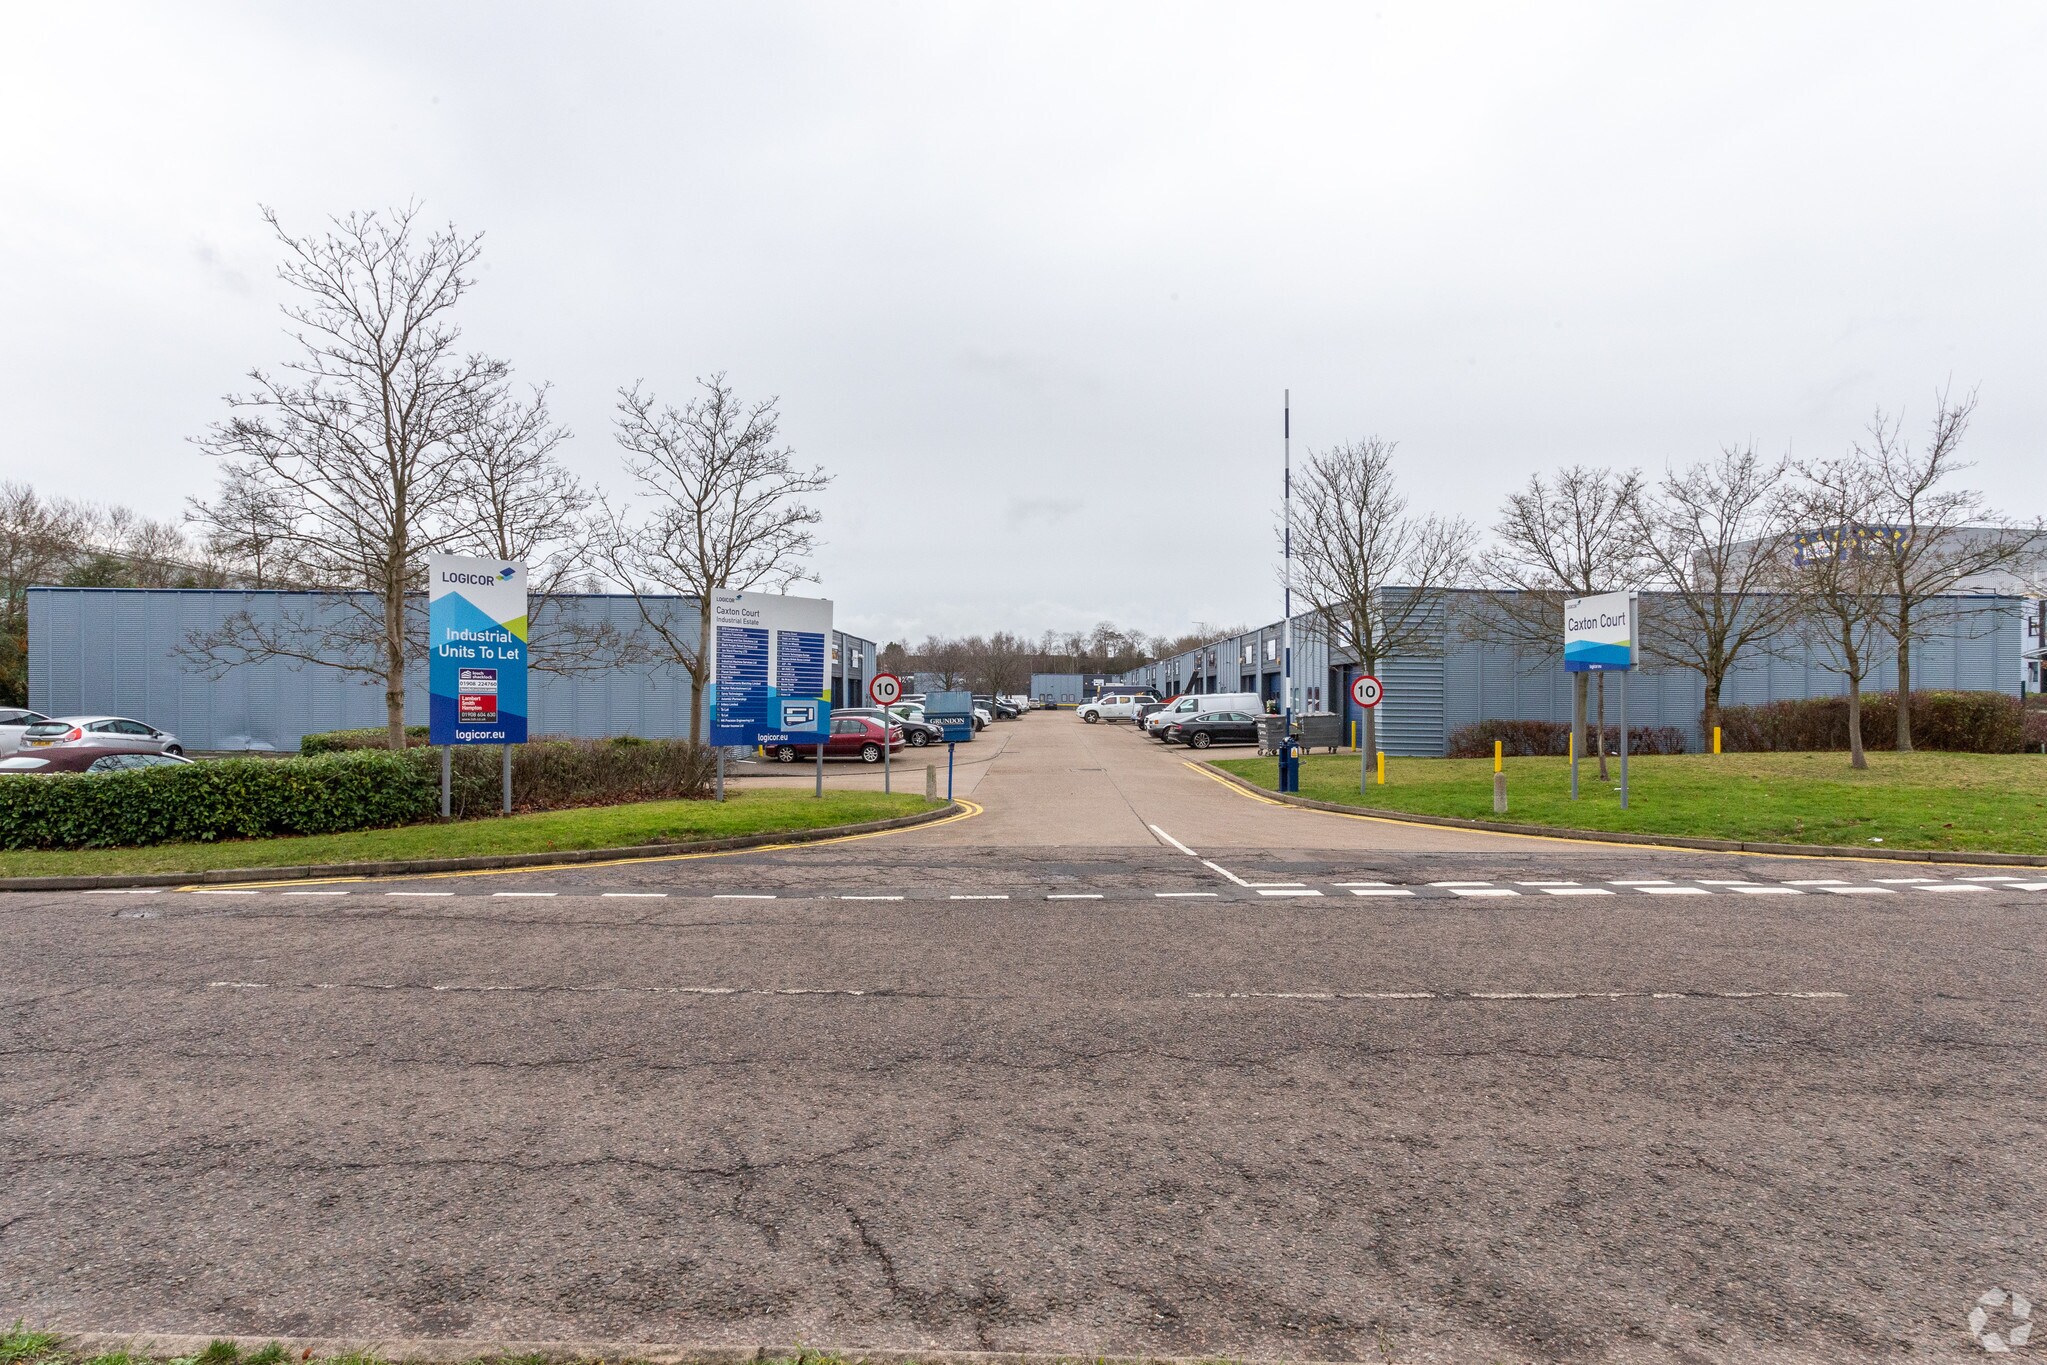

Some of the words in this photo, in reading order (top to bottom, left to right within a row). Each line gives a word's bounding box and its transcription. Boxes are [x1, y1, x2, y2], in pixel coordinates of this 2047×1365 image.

[442, 572, 494, 586] LOGICOR
[716, 606, 739, 616] Caxton
[742, 608, 760, 617] Court
[1569, 618, 1597, 631] Caxton
[1600, 613, 1625, 628] Court
[447, 628, 512, 643] Industrial
[439, 645, 475, 658] Units
[479, 646, 494, 658] To
[498, 647, 519, 659] Let
[877, 683, 894, 695] 10
[1358, 684, 1375, 698] 10
[456, 729, 505, 742] logicor.eu
[758, 734, 788, 742] logicor.eu
